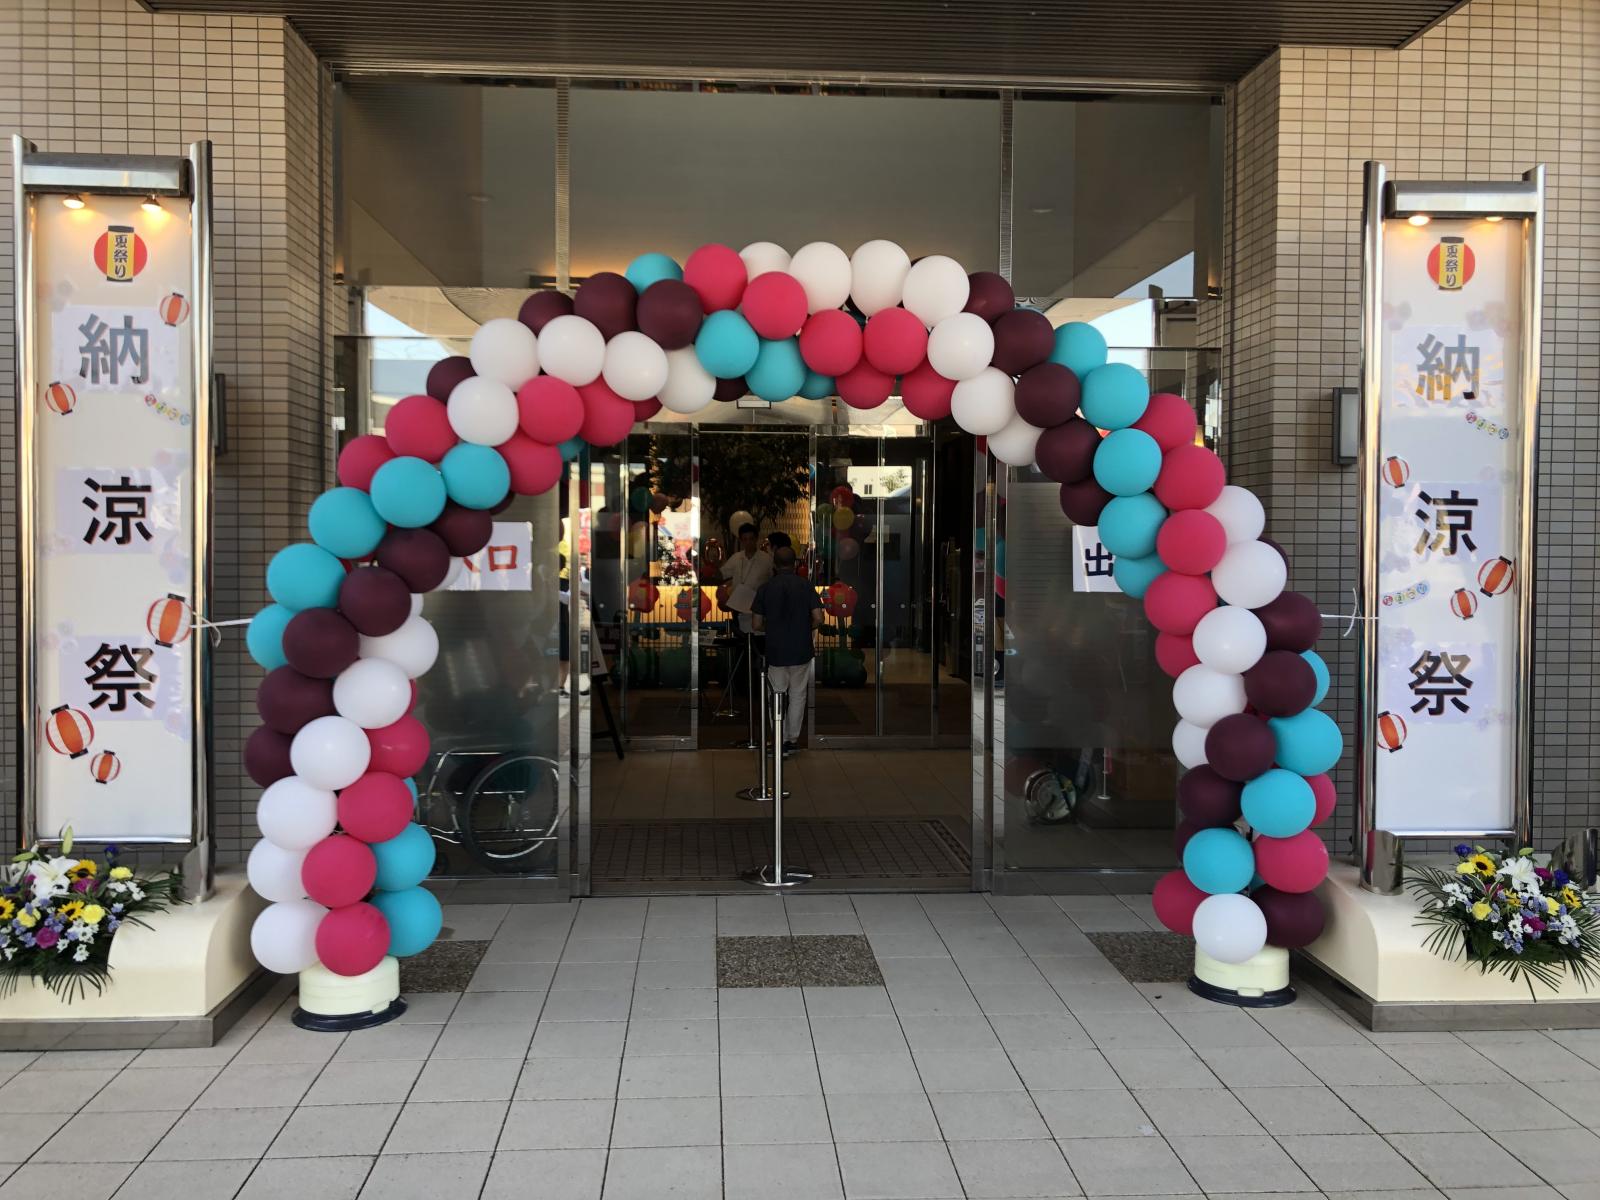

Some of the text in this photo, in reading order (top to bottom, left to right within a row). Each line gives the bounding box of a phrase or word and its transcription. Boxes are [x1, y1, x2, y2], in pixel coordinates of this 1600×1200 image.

[113, 234, 129, 278] 夏祭り
[1445, 244, 1459, 287] 夏祭り
